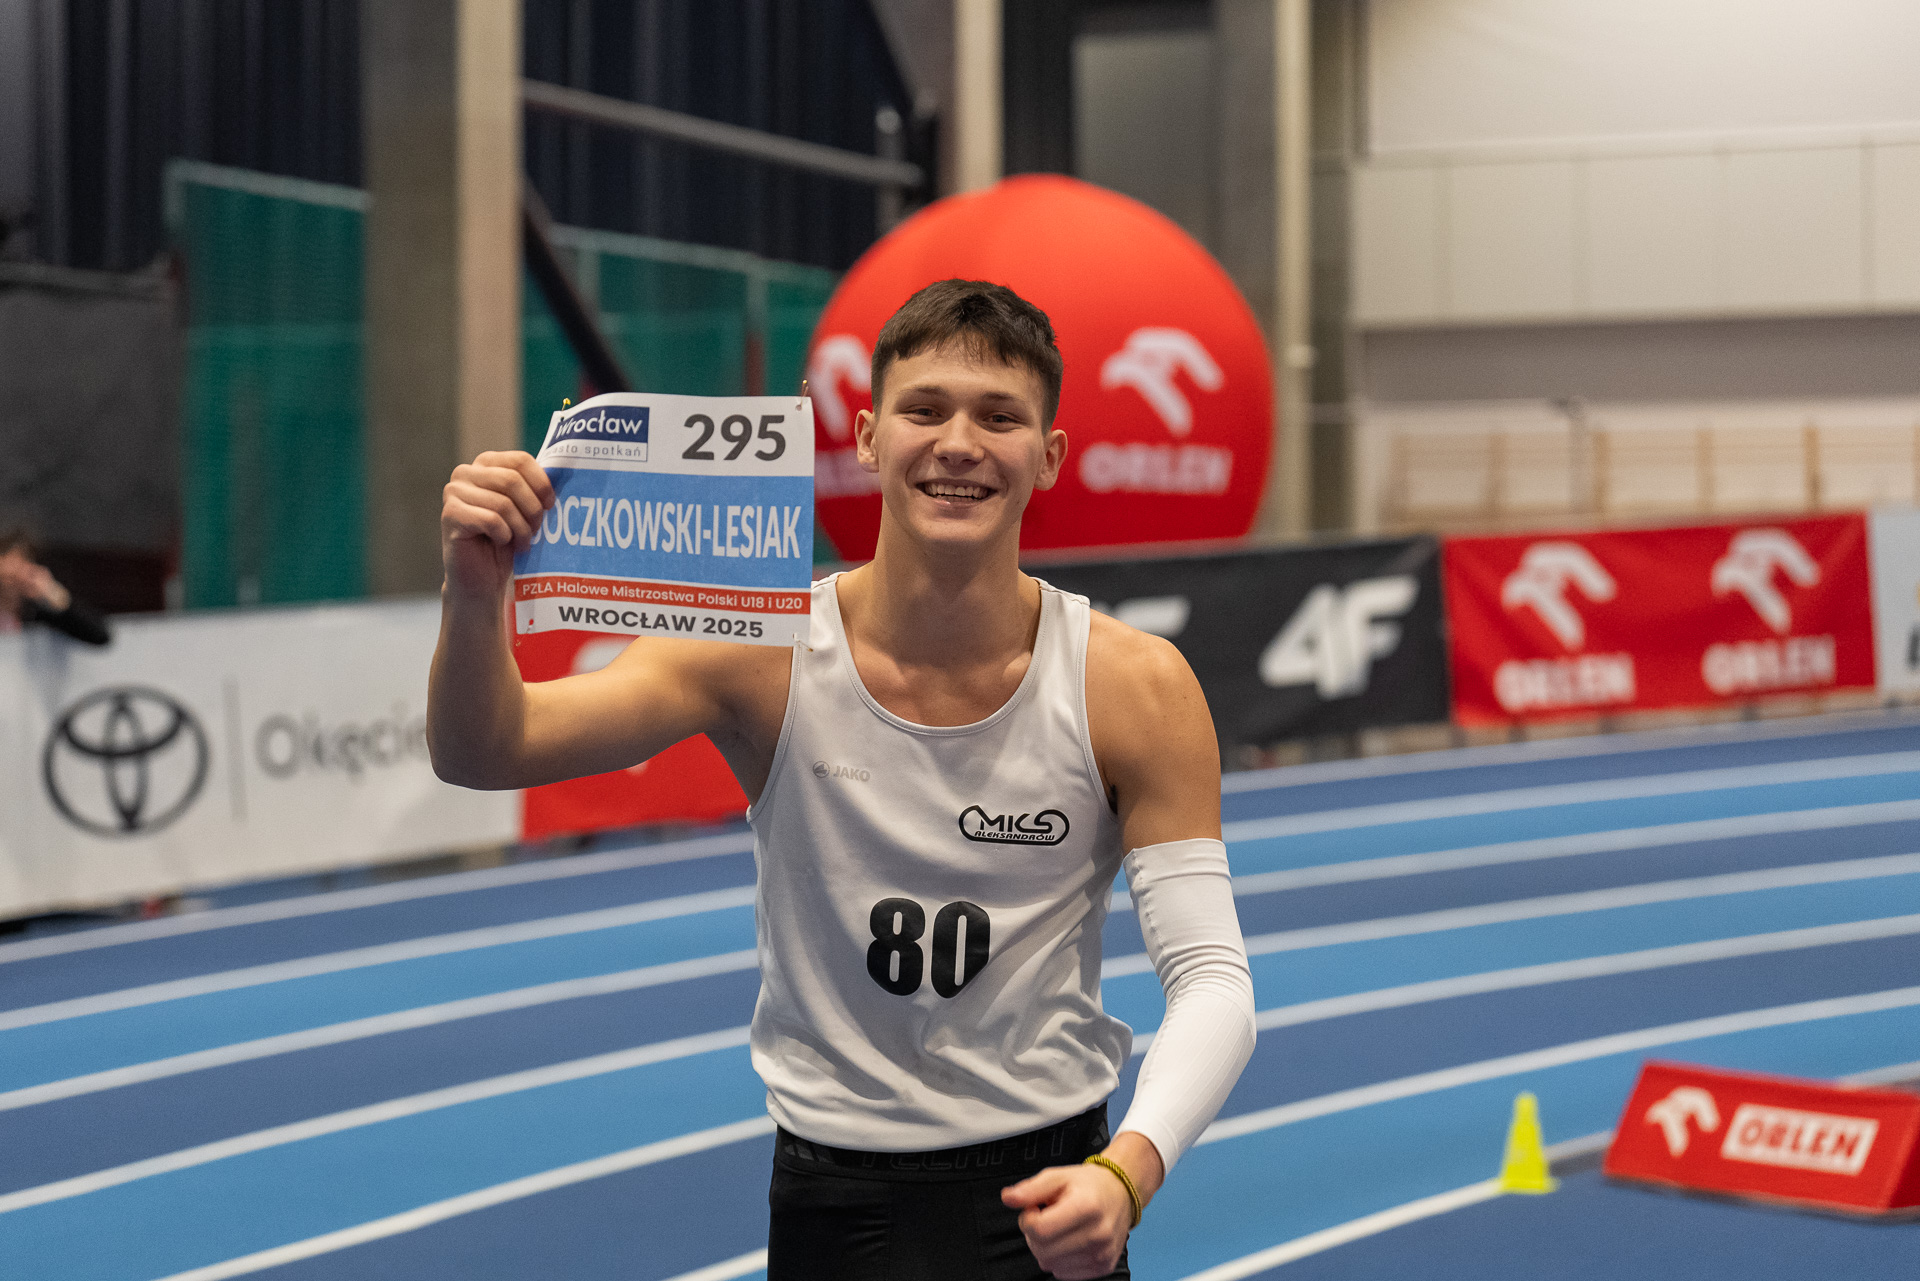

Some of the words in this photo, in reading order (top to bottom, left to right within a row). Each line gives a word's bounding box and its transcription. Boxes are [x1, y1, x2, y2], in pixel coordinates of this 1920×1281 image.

[585, 444, 641, 457] spotkań
[681, 413, 787, 462] 295
[1079, 441, 1233, 496] ORLEN
[531, 495, 802, 559] OCZKOWSKI-LESIAK
[523, 582, 553, 595] PZLA
[557, 582, 609, 596] Halowe
[612, 586, 694, 602] Mistrzostwa
[698, 593, 737, 606] Polski
[741, 596, 765, 609] U18
[768, 597, 772, 608] i
[776, 597, 803, 609] U20
[558, 605, 696, 632] WROCŁAW
[703, 617, 763, 638] 2025
[1259, 574, 1419, 699] 4F
[1494, 652, 1635, 713] ORLEN
[1701, 633, 1837, 695] ORLEN
[833, 765, 871, 782] JAKO
[974, 830, 1055, 841] ALEKSANDRÓW
[866, 897, 991, 999] 80
